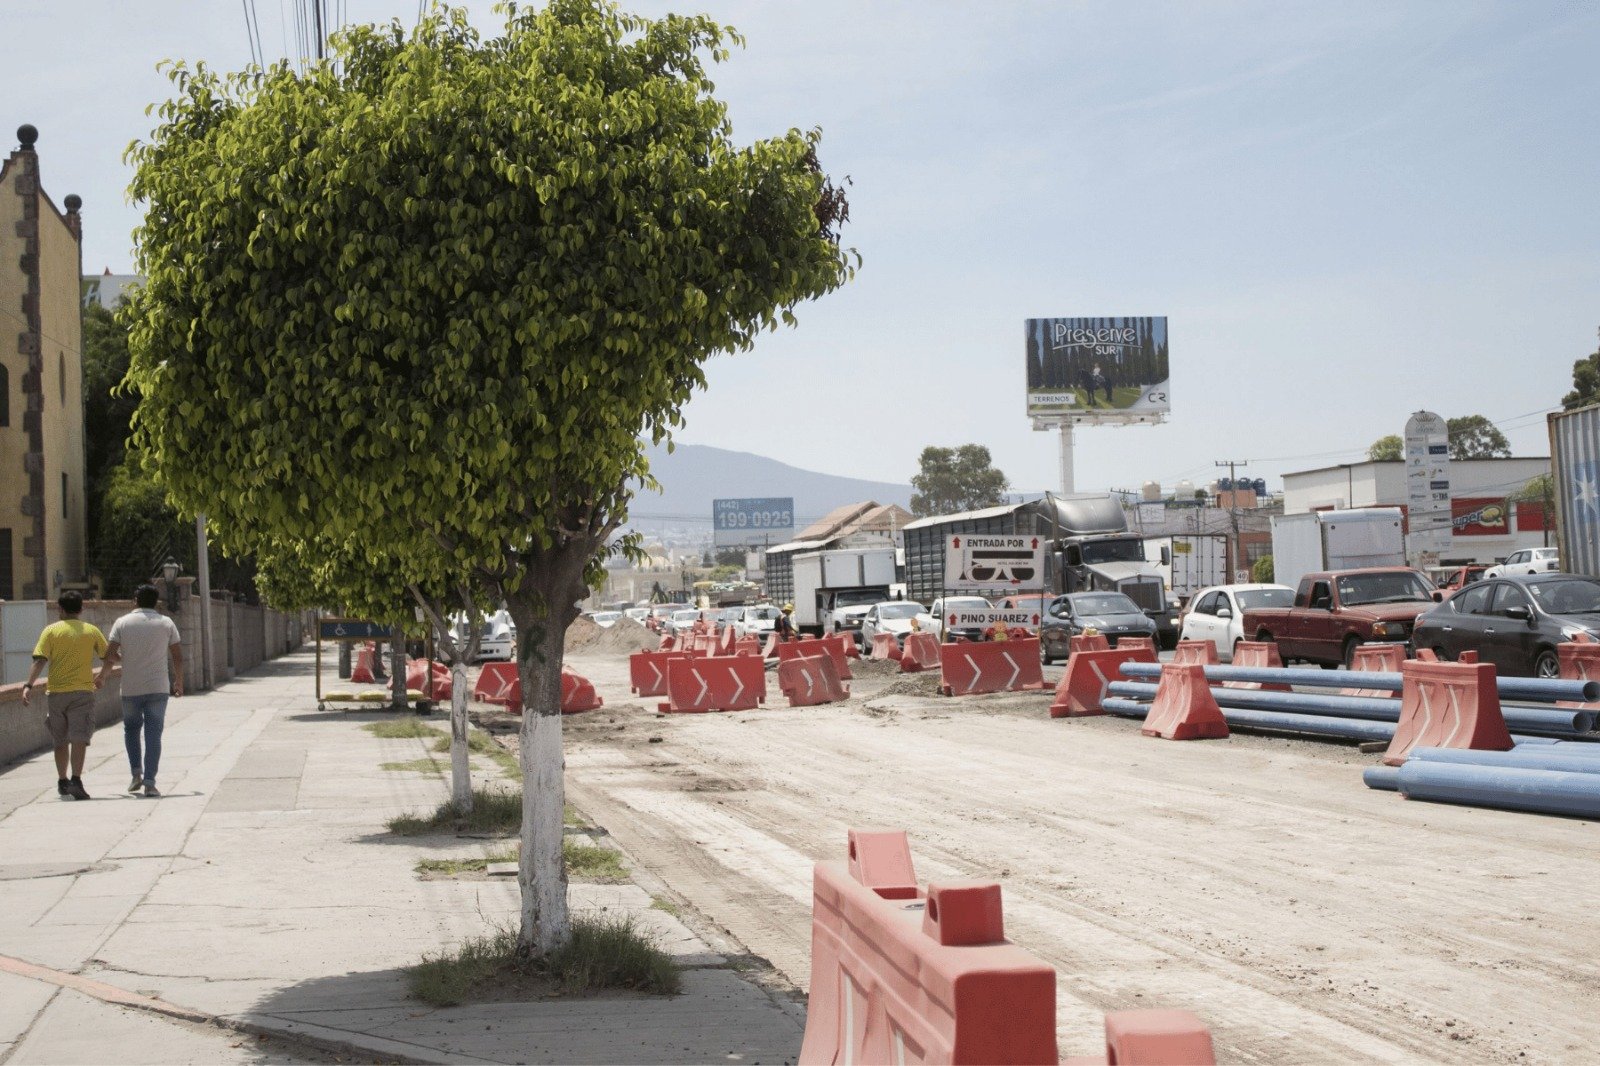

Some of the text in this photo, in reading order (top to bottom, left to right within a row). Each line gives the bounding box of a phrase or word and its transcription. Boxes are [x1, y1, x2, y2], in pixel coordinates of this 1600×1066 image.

[1055, 323, 1136, 348] Preserve
[1095, 346, 1117, 355] SUR
[967, 539, 1024, 548] ENTRADA POR
[961, 614, 1028, 623] PINO SUAREZ
